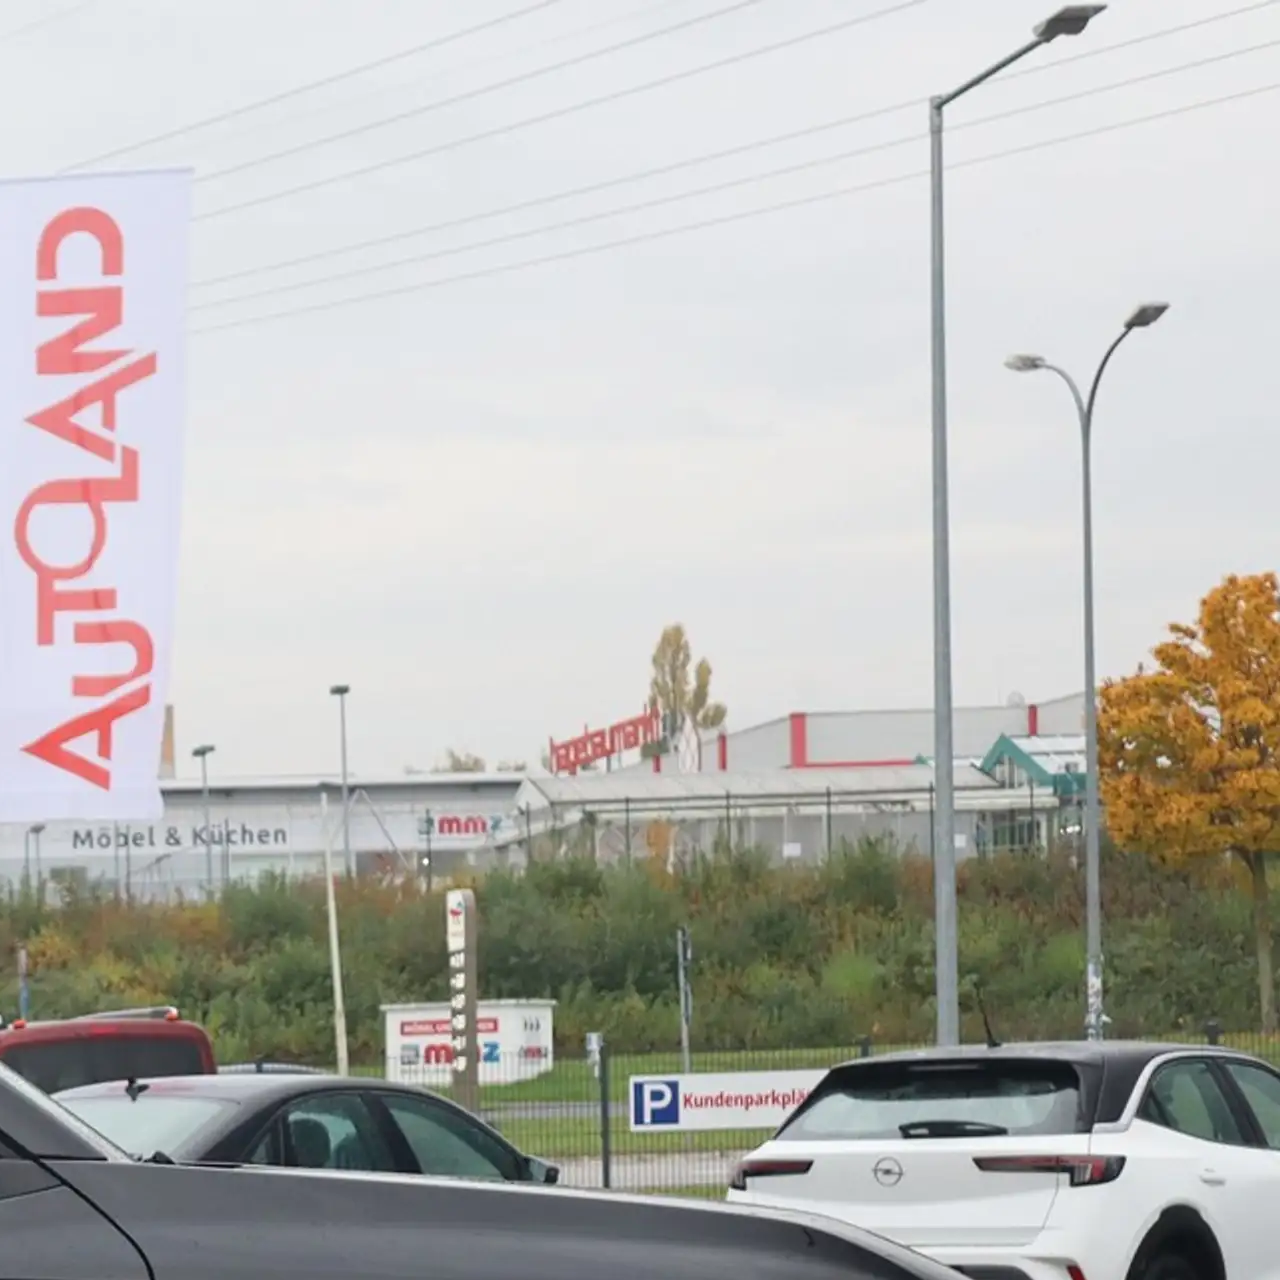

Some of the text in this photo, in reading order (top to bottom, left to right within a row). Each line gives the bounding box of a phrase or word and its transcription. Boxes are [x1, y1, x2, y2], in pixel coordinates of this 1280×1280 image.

[14, 207, 157, 791] AUTOLAND
[72, 822, 288, 849] Möbel & Küchen
[643, 1083, 672, 1124] P
